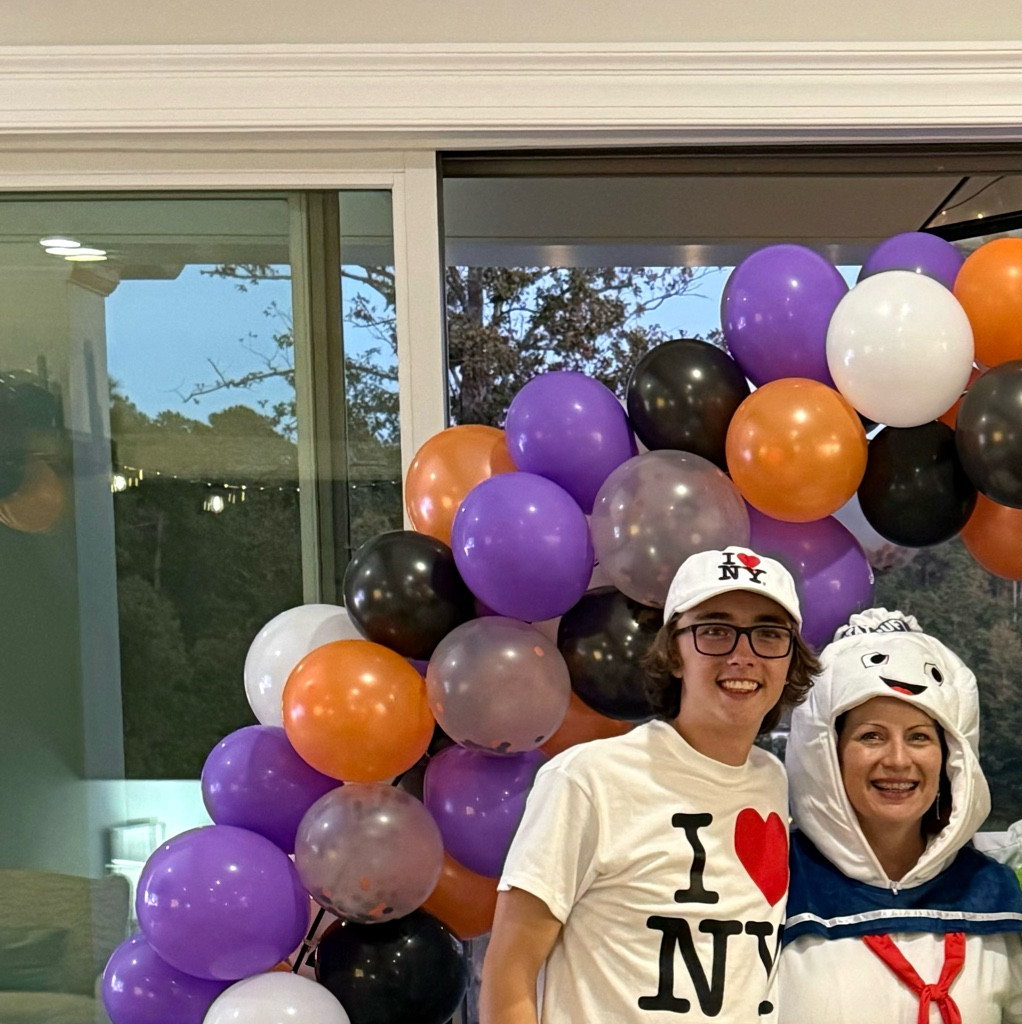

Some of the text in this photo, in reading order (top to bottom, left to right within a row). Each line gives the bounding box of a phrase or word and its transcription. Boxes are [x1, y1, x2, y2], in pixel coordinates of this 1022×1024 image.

[722, 552, 736, 565] I
[718, 565, 767, 584] NY
[671, 812, 720, 905] I
